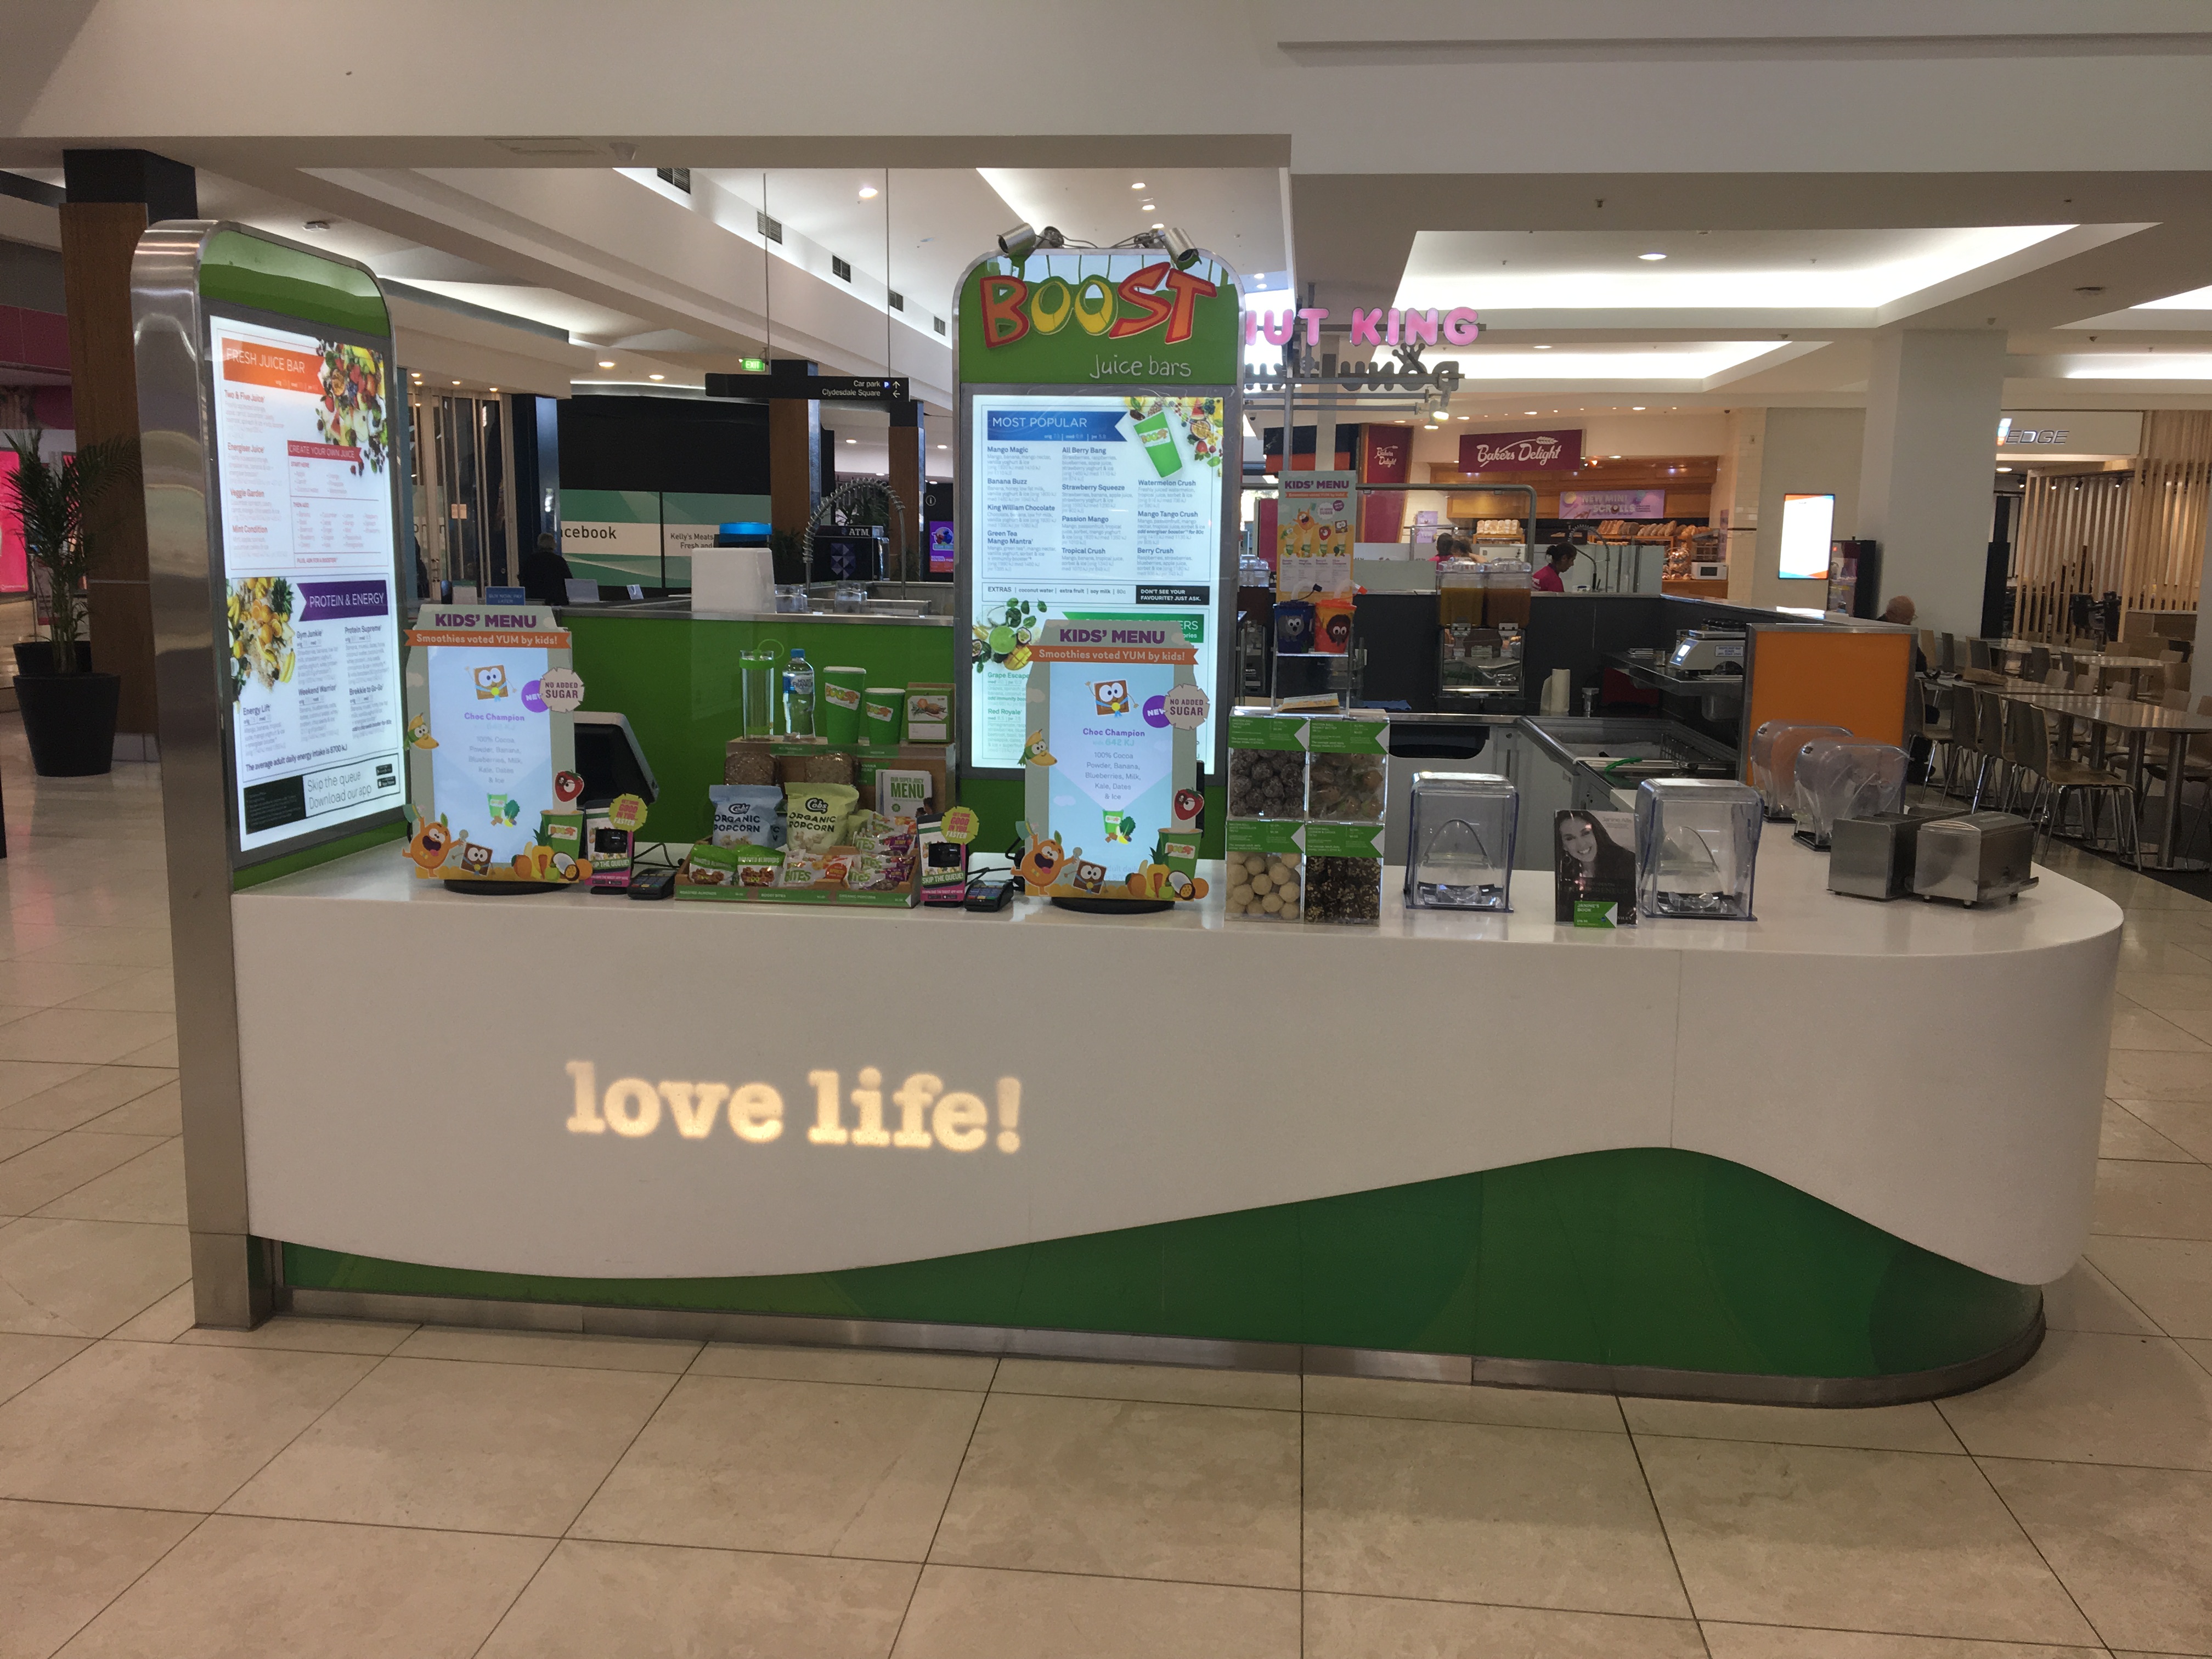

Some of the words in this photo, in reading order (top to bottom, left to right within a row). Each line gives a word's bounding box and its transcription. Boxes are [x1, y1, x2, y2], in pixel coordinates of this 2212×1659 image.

[980, 262, 1217, 348] BOOST
[1351, 307, 1479, 346] KING
[227, 348, 257, 365] FRESH
[259, 354, 285, 370] JUICE
[286, 359, 305, 373] BAR
[745, 360, 760, 369] EXIT
[1149, 355, 1191, 377] bars
[992, 417, 1026, 427] MOST
[1030, 417, 1087, 427] POPULAR
[2006, 430, 2070, 444] EDGE
[289, 444, 309, 454] CREATE
[311, 447, 325, 456] YOUR
[326, 448, 340, 457] OWN
[341, 450, 355, 459] JUICE
[988, 446, 1008, 454] Mango
[1476, 444, 1515, 467] Bakers
[1518, 443, 1562, 466] Delight
[1285, 481, 1314, 489] KIDS'
[1317, 481, 1349, 489] MENU
[230, 488, 246, 499] Veggie
[247, 489, 264, 498] Garden
[244, 525, 268, 533] Condition
[849, 528, 870, 537] ATM
[670, 533, 692, 541] Kelly's
[309, 595, 343, 608] PROTEIN
[345, 594, 351, 606] &
[352, 592, 384, 605] ENERGY
[435, 613, 481, 628] KIDS'
[484, 614, 537, 628] MENU
[297, 631, 307, 640] Gym
[416, 634, 466, 644] Smoothies
[467, 634, 495, 644] voted
[496, 635, 519, 644] YUM
[521, 635, 533, 647] by
[534, 635, 557, 645] kids!
[1059, 628, 1107, 643] KIDS'
[1111, 629, 1165, 644] MENU
[1039, 649, 1090, 659] Smoothies
[1092, 650, 1120, 659] voted
[1122, 651, 1146, 660] YUM
[1148, 651, 1160, 662] by
[1162, 651, 1185, 661] kids!
[298, 687, 319, 696] Weekend
[545, 690, 578, 698] SUGAR
[1170, 706, 1204, 716] SUGAR
[464, 712, 484, 720] Choc
[486, 713, 525, 722] Champion
[1105, 729, 1146, 737] Champion
[255, 761, 273, 771] average
[273, 758, 285, 766] adult
[286, 755, 297, 764] daily
[297, 753, 312, 762] energy
[312, 749, 325, 758] intake
[307, 778, 324, 793] Skip
[325, 776, 338, 788] the
[340, 771, 362, 785] queue
[890, 782, 924, 799] MENU
[309, 793, 346, 810] Download
[347, 789, 358, 799] our
[359, 783, 372, 797] app
[619, 804, 639, 813] GOOD
[806, 798, 828, 812] Cobs
[613, 817, 635, 826] FASTER
[714, 814, 761, 823] ORGANIC
[788, 812, 837, 823] ORGANIC
[950, 817, 970, 826] GOOD
[714, 824, 760, 832] POPCORN
[788, 821, 834, 832] POPCORN
[946, 831, 967, 839] FASTER
[565, 1060, 783, 1143] love
[806, 1066, 1022, 1154] life!
